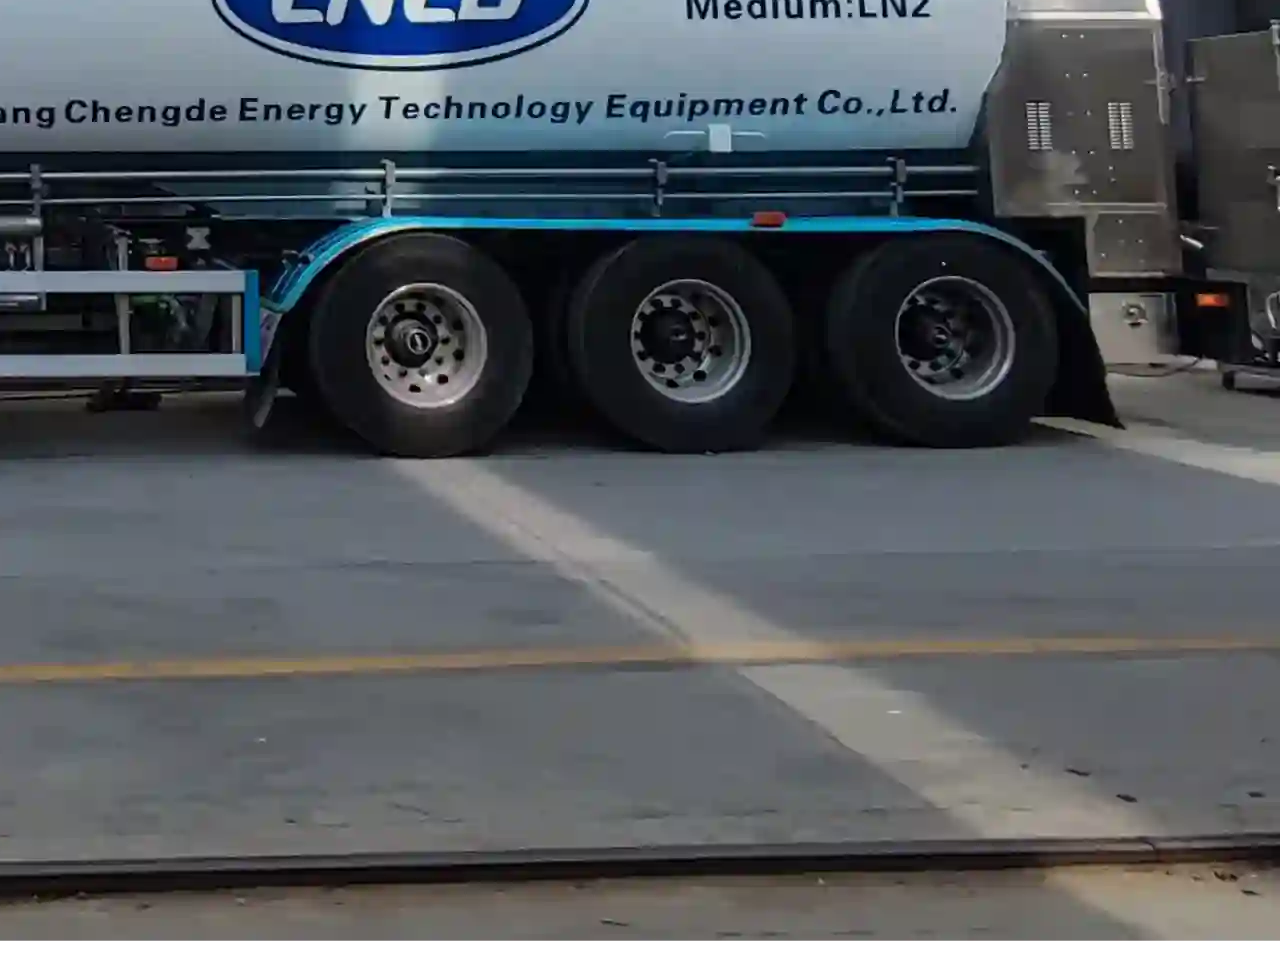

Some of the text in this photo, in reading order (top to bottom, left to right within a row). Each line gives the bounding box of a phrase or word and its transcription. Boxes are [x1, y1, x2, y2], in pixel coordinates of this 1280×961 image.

[64, 97, 228, 128] Chengde
[238, 97, 369, 127] Energy
[378, 93, 594, 126] Technology
[605, 92, 810, 124] Equipment
[817, 88, 958, 119] Co.,Ltd.
